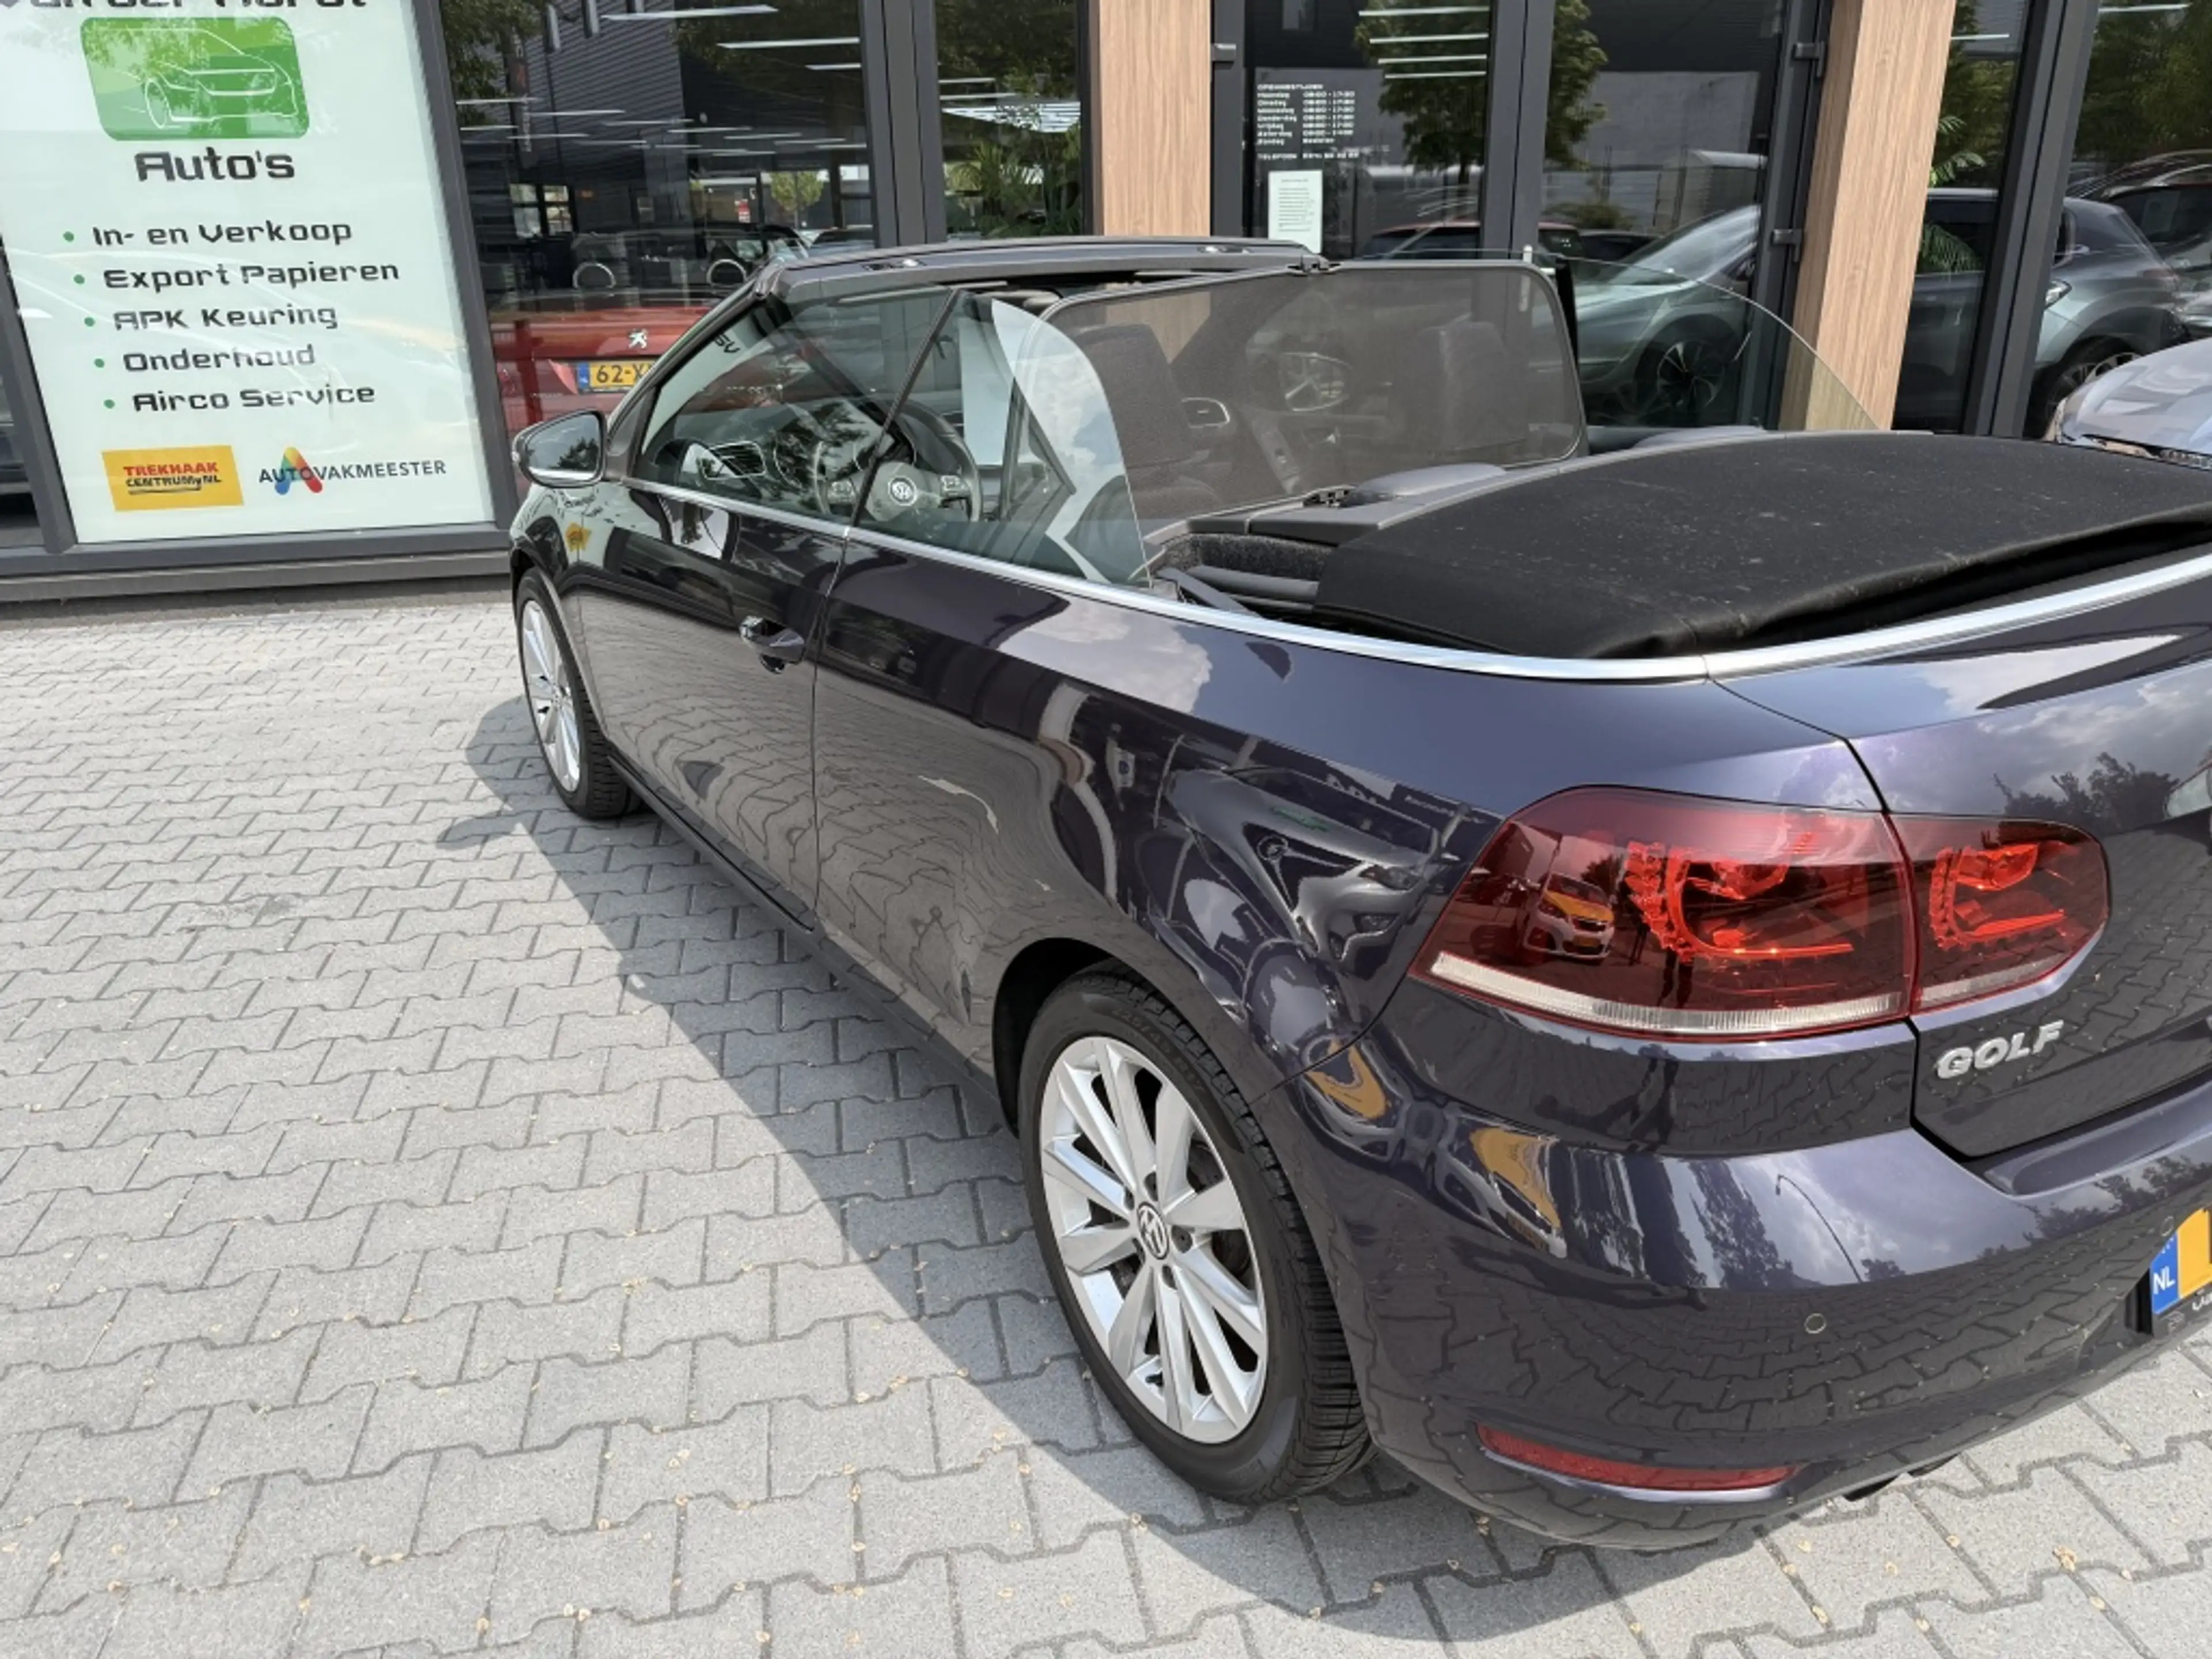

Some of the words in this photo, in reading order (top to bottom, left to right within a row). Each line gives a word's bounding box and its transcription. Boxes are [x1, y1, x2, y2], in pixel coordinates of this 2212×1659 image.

[134, 146, 294, 181] Auto's
[93, 227, 134, 246] In-
[147, 228, 188, 245] en
[198, 220, 351, 245] Verkoop
[104, 261, 230, 294] Export
[240, 259, 399, 291] Papieren
[113, 308, 190, 332] APK
[201, 304, 338, 330] Keuring
[122, 344, 315, 373] Onderhoud
[132, 391, 229, 413] Airco
[240, 383, 376, 408] Service
[123, 462, 219, 476] TREKHAAK
[259, 460, 447, 484] AUTOVAKMEESTER
[1937, 1019, 2064, 1079] GOLF
[2153, 1265, 2176, 1296] NL
